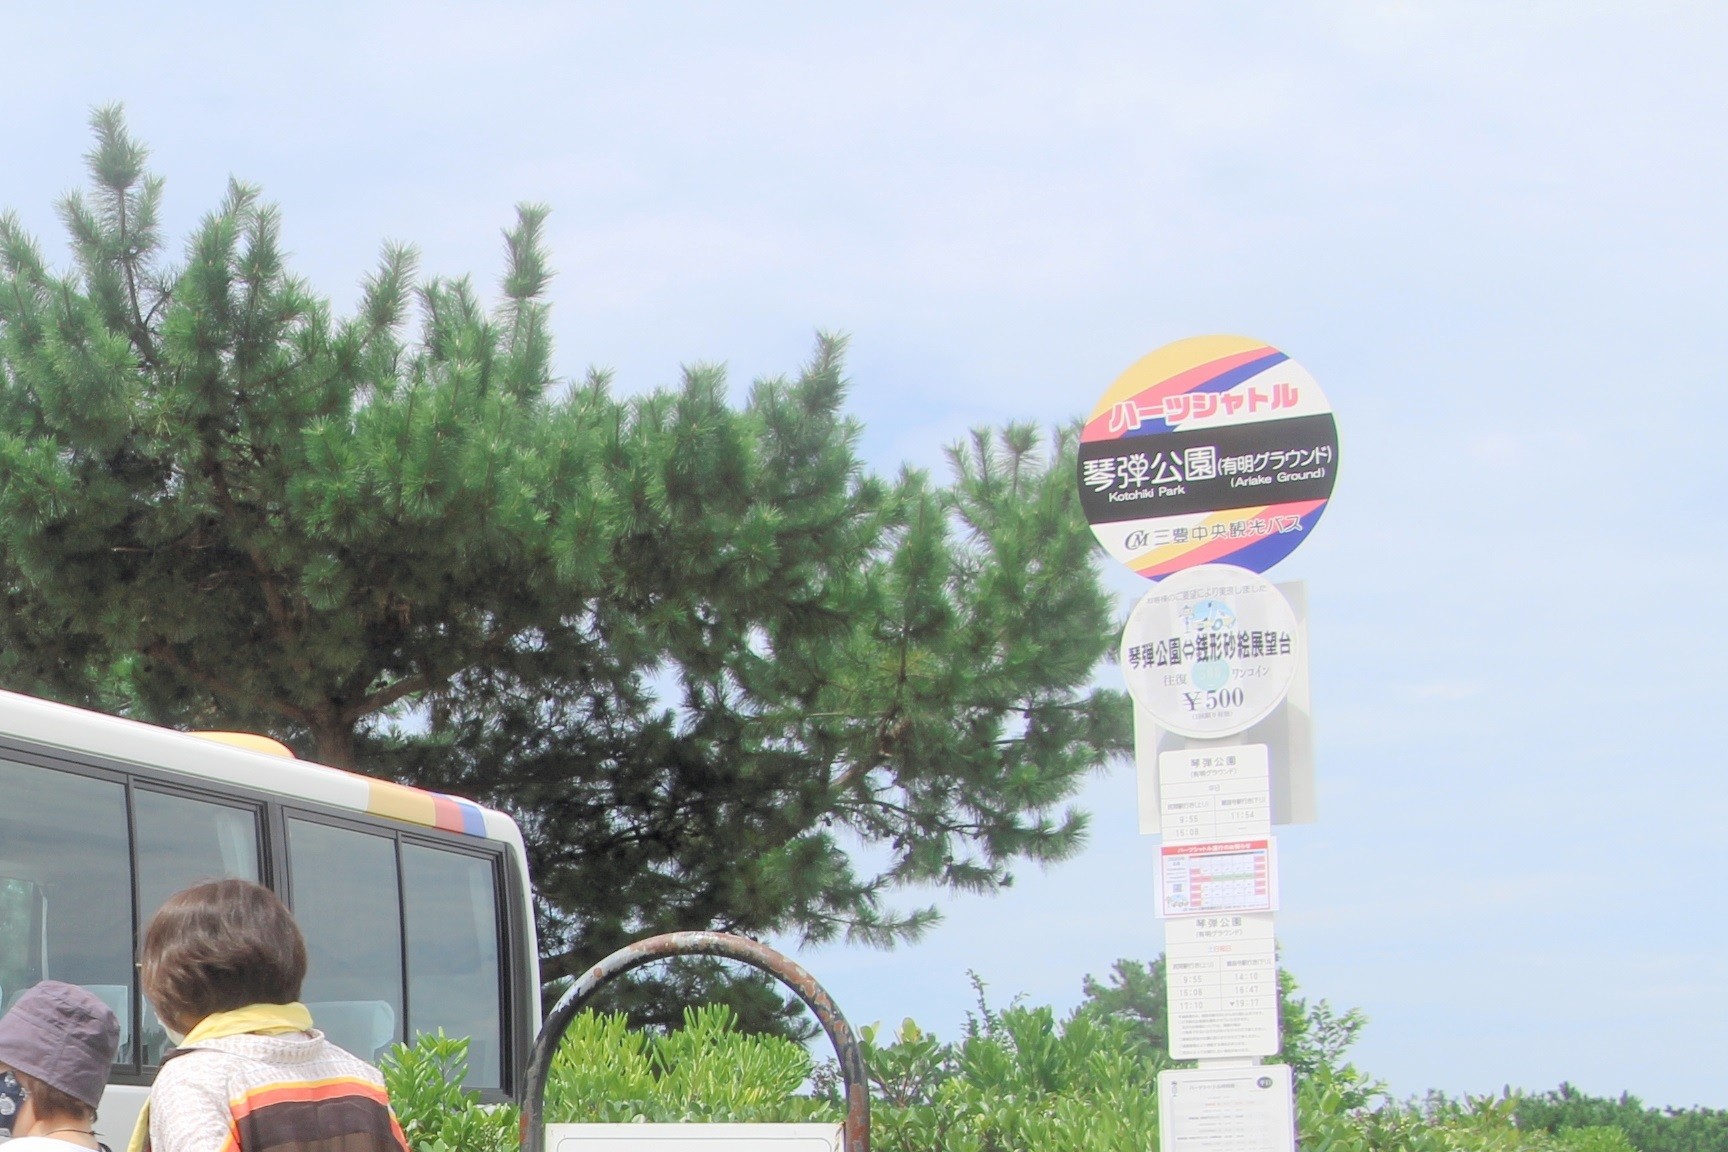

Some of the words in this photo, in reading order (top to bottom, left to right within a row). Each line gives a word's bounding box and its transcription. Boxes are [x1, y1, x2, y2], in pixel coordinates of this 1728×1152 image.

[1109, 383, 1299, 432] ハーツシャトル
[1230, 475, 1272, 488] (Ariake
[1277, 468, 1326, 484] Ground)
[1108, 489, 1154, 503] Kotohiki
[1159, 485, 1186, 497] Park
[1153, 514, 1303, 547] 三豊中央観光バス
[1232, 664, 1270, 681] ワンコイン
